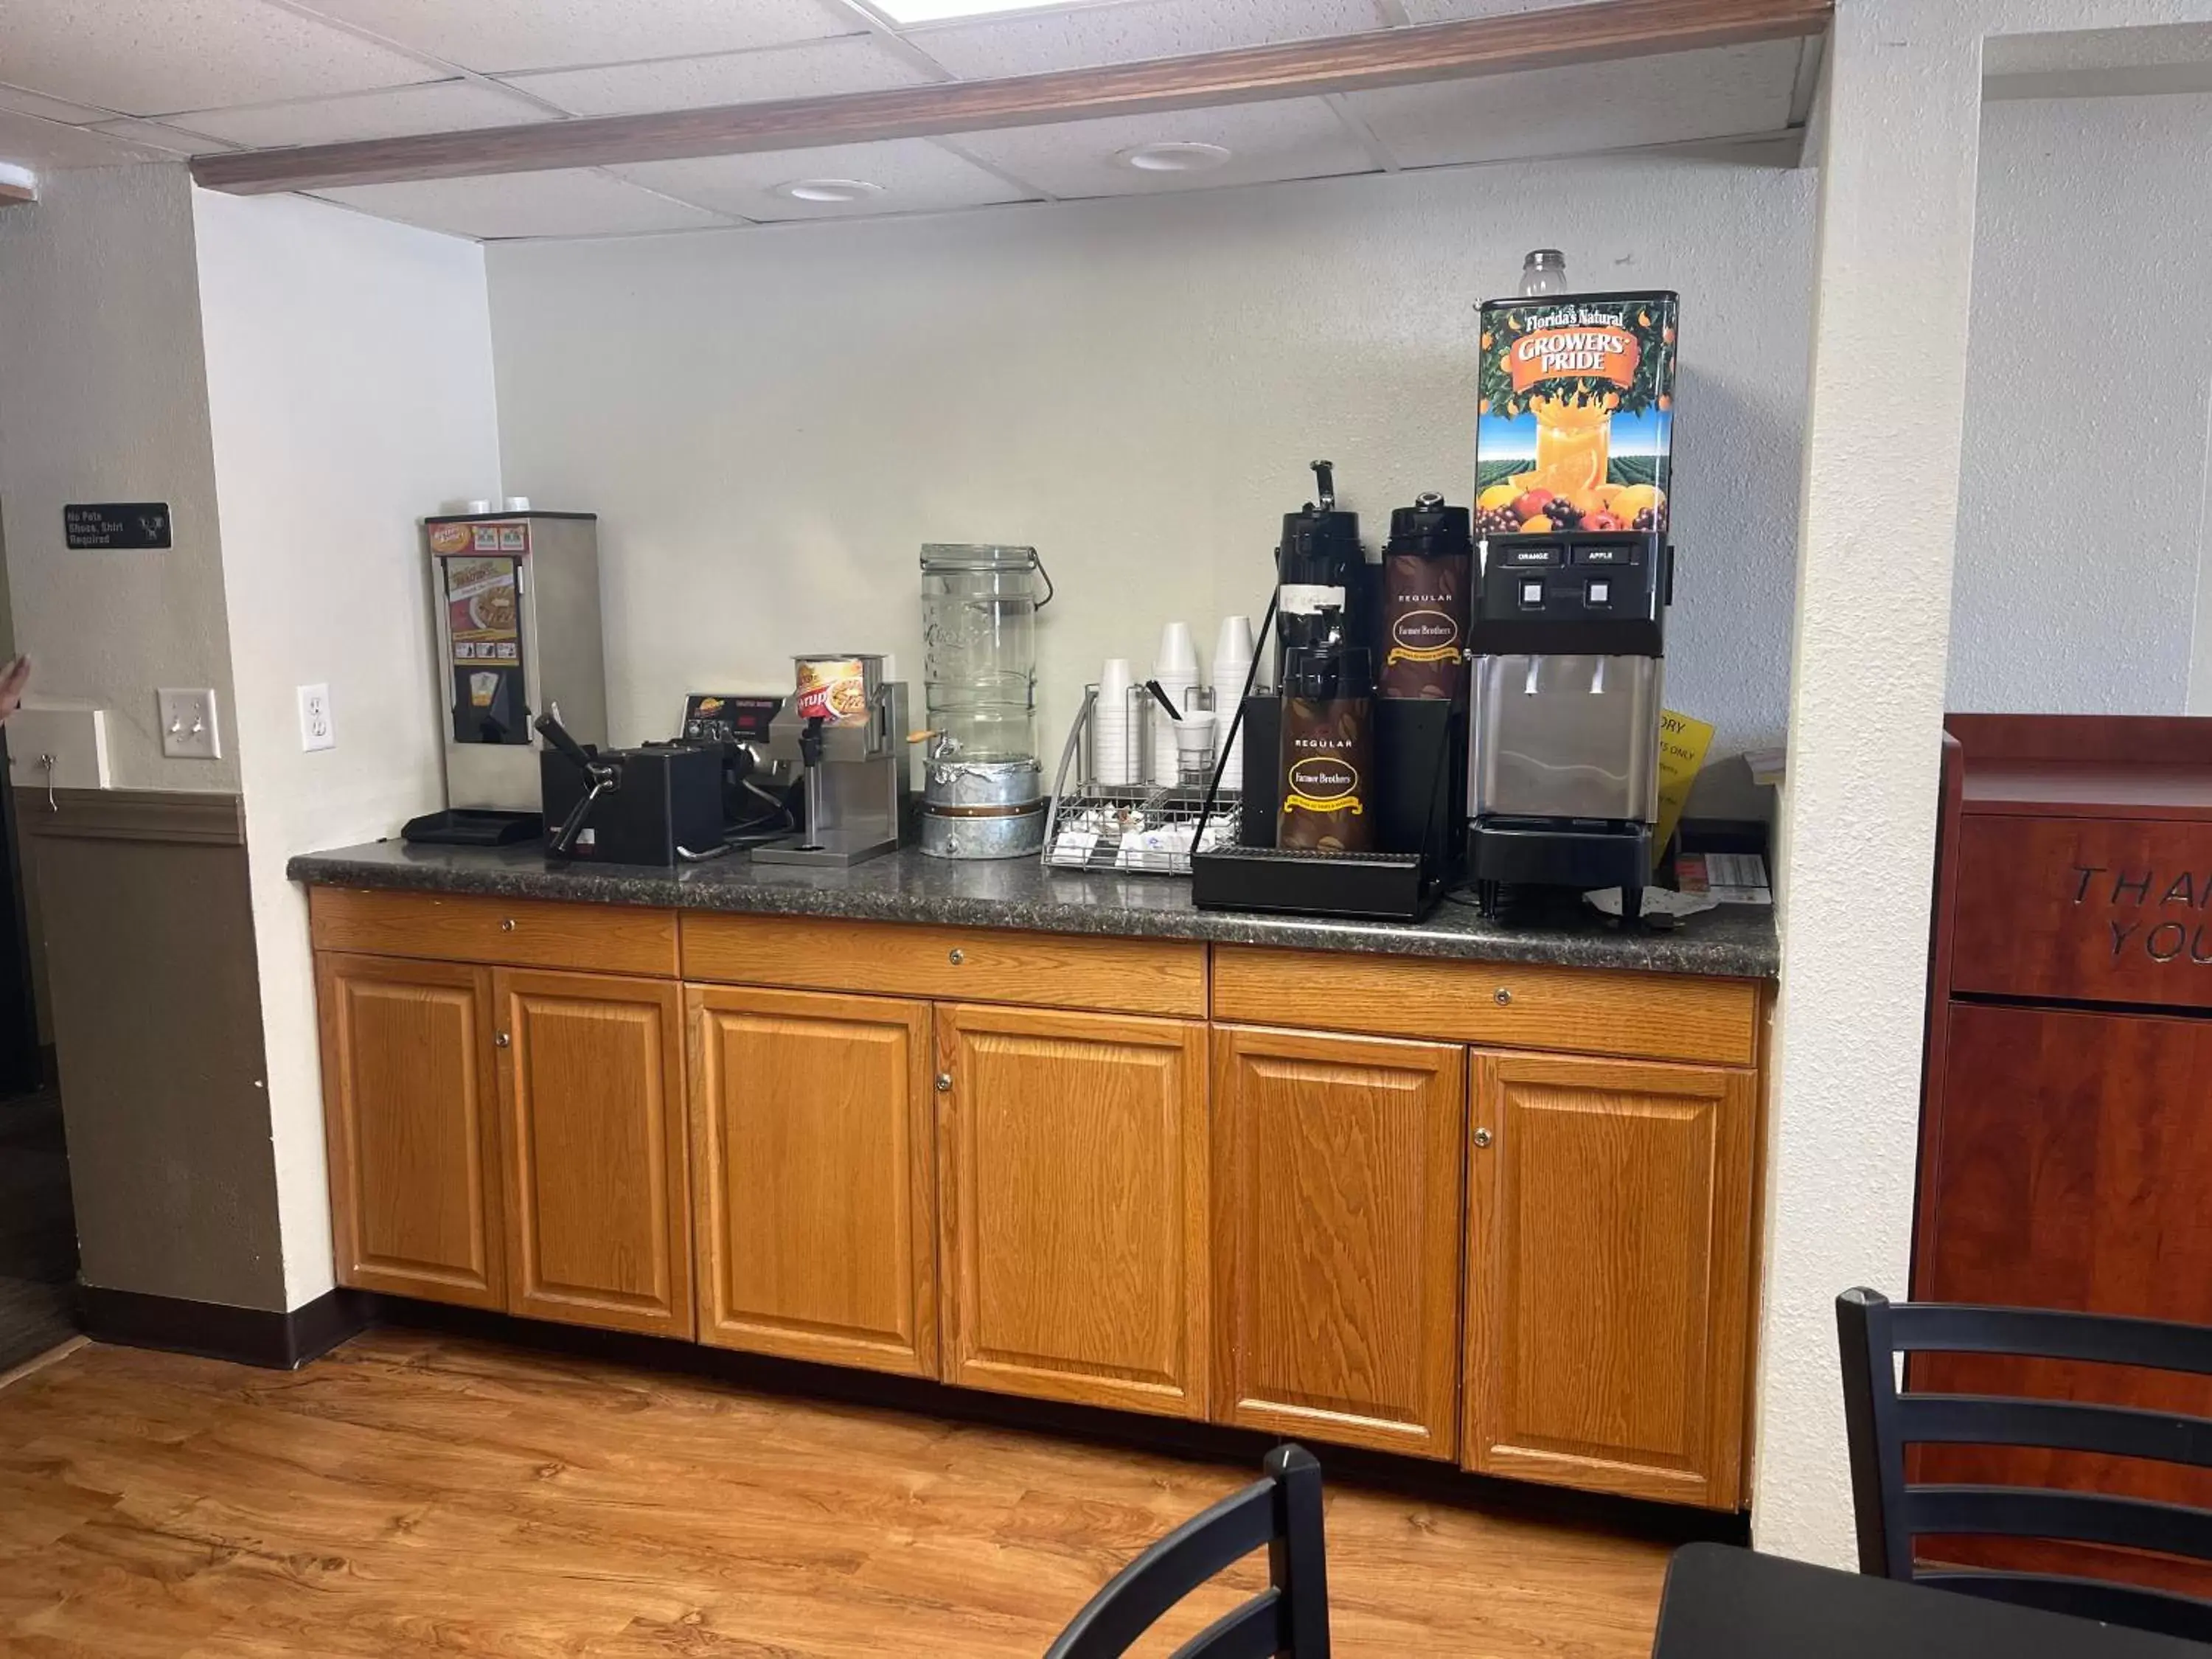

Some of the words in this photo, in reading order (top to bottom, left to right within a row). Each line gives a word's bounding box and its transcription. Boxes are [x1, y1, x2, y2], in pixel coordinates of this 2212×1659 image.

[1526, 310, 1577, 332] Florida's
[1579, 308, 1624, 326] Natural
[1541, 352, 1605, 372] PRIDE
[67, 512, 79, 521] No
[101, 522, 124, 532] Shirt
[69, 535, 110, 545] Required
[1421, 625, 1451, 635] Brothers
[1295, 740, 1352, 748] REGULAR
[1670, 745, 1695, 760] ONLY
[1295, 772, 1318, 782] Farmer
[1319, 772, 1351, 783] Brothers
